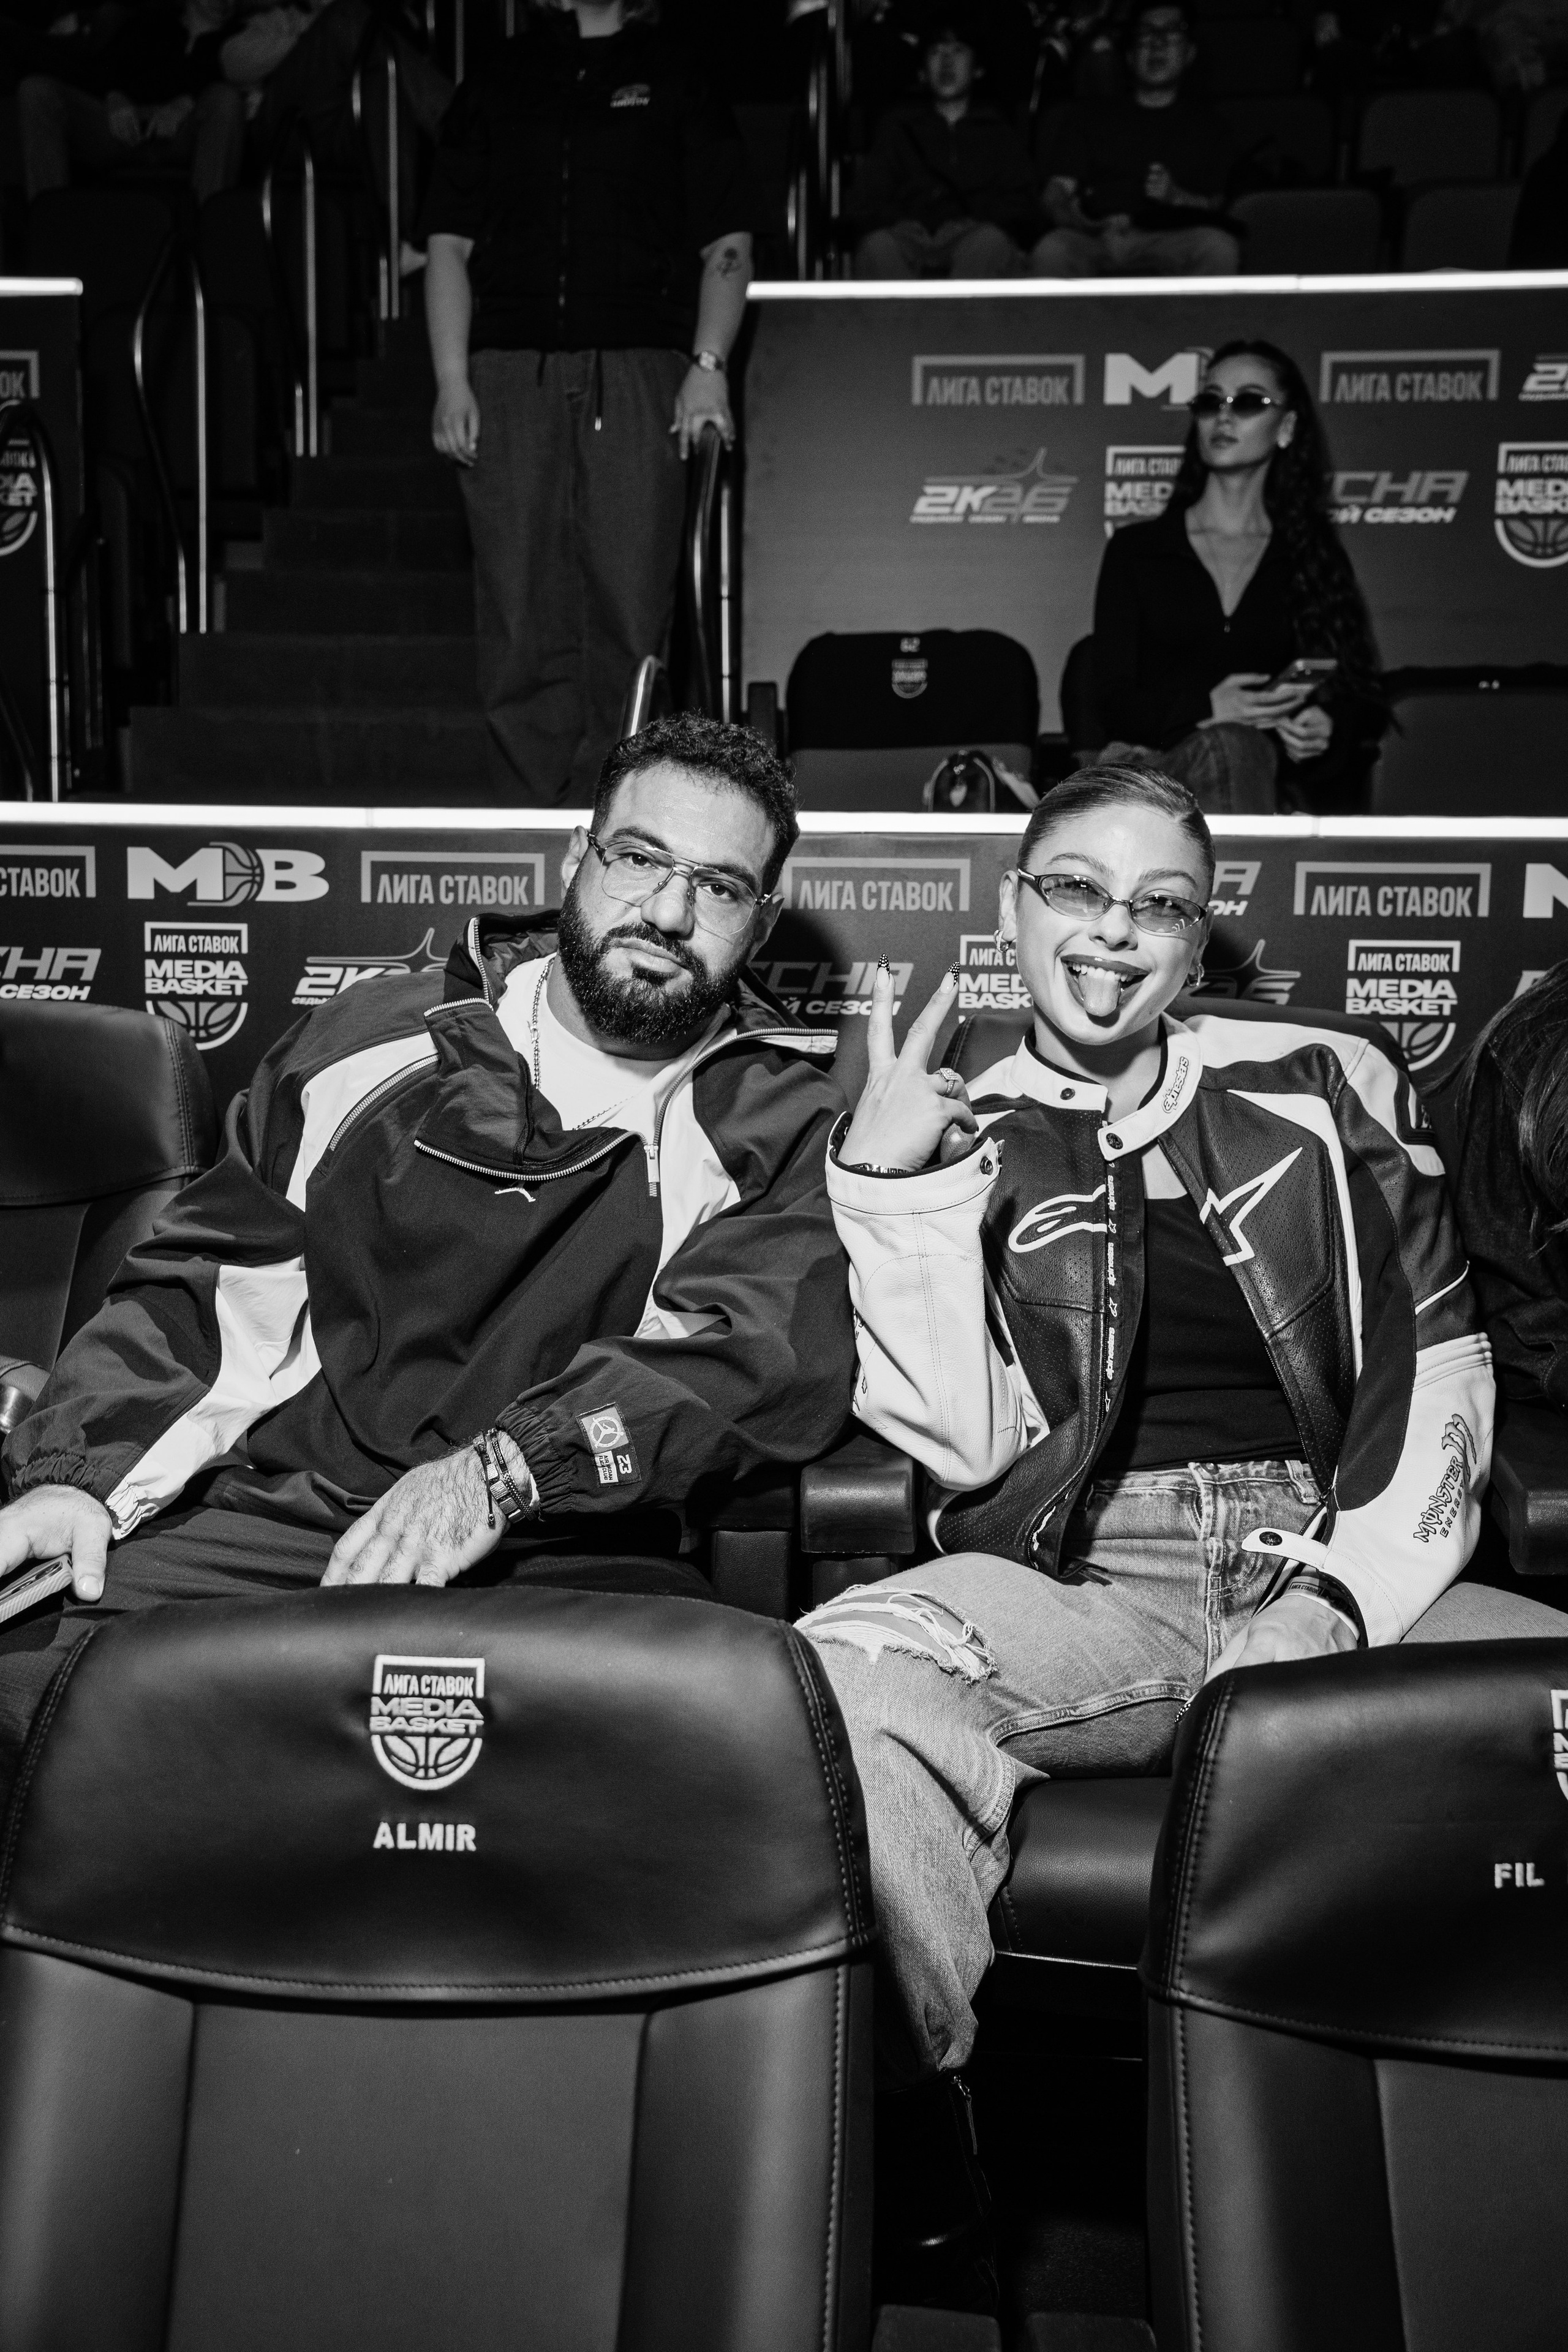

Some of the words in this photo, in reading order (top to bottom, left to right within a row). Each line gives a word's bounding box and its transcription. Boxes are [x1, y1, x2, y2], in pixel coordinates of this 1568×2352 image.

[927, 376, 980, 405] ЛИГА
[984, 376, 1070, 405] СТАВОК
[1104, 353, 1199, 405] M
[1335, 372, 1392, 402] ЛИГА
[1394, 372, 1484, 402] СТАВОК
[1104, 481, 1175, 499] MED
[1324, 470, 1469, 504] СНА
[1496, 478, 1568, 497] MED
[911, 485, 1073, 515] 2K26
[377, 874, 434, 904] ЛИГА
[439, 875, 529, 905] СТАВОК
[797, 880, 857, 910] ЛИГА
[861, 881, 954, 911] СТАВОК
[1311, 886, 1372, 917] ЛИГА
[1376, 886, 1474, 918] СТАВОК
[153, 934, 187, 952] ЛИГА
[187, 935, 239, 954] СТАВОК
[144, 959, 248, 980] MEDIA
[968, 948, 1004, 966] ЛИГА
[1357, 952, 1393, 971] ЛИГА
[1395, 954, 1450, 973] СТАВОК
[145, 978, 249, 996] BASKET
[748, 961, 914, 996] СНА
[959, 973, 1030, 993] MED
[1346, 979, 1458, 998] MEDIA
[0, 984, 91, 1001] СЕЗОН
[958, 992, 1033, 1009] BASK
[1346, 997, 1458, 1016] BASKET
[1163, 1055, 1190, 1112] alpinestars
[1107, 1242, 1117, 1286] alpinestars
[1105, 1327, 1115, 1379] alpinestars
[616, 1453, 632, 1474] 23
[1413, 1455, 1463, 1543] MONSTER
[383, 1673, 420, 1695] ЛИГА
[421, 1675, 474, 1698] СТАВОК
[371, 1696, 484, 1719] MEDIA
[369, 1716, 484, 1735] BASKET
[372, 1821, 477, 1852] ALMIR
[1494, 1862, 1545, 1889] FIL
